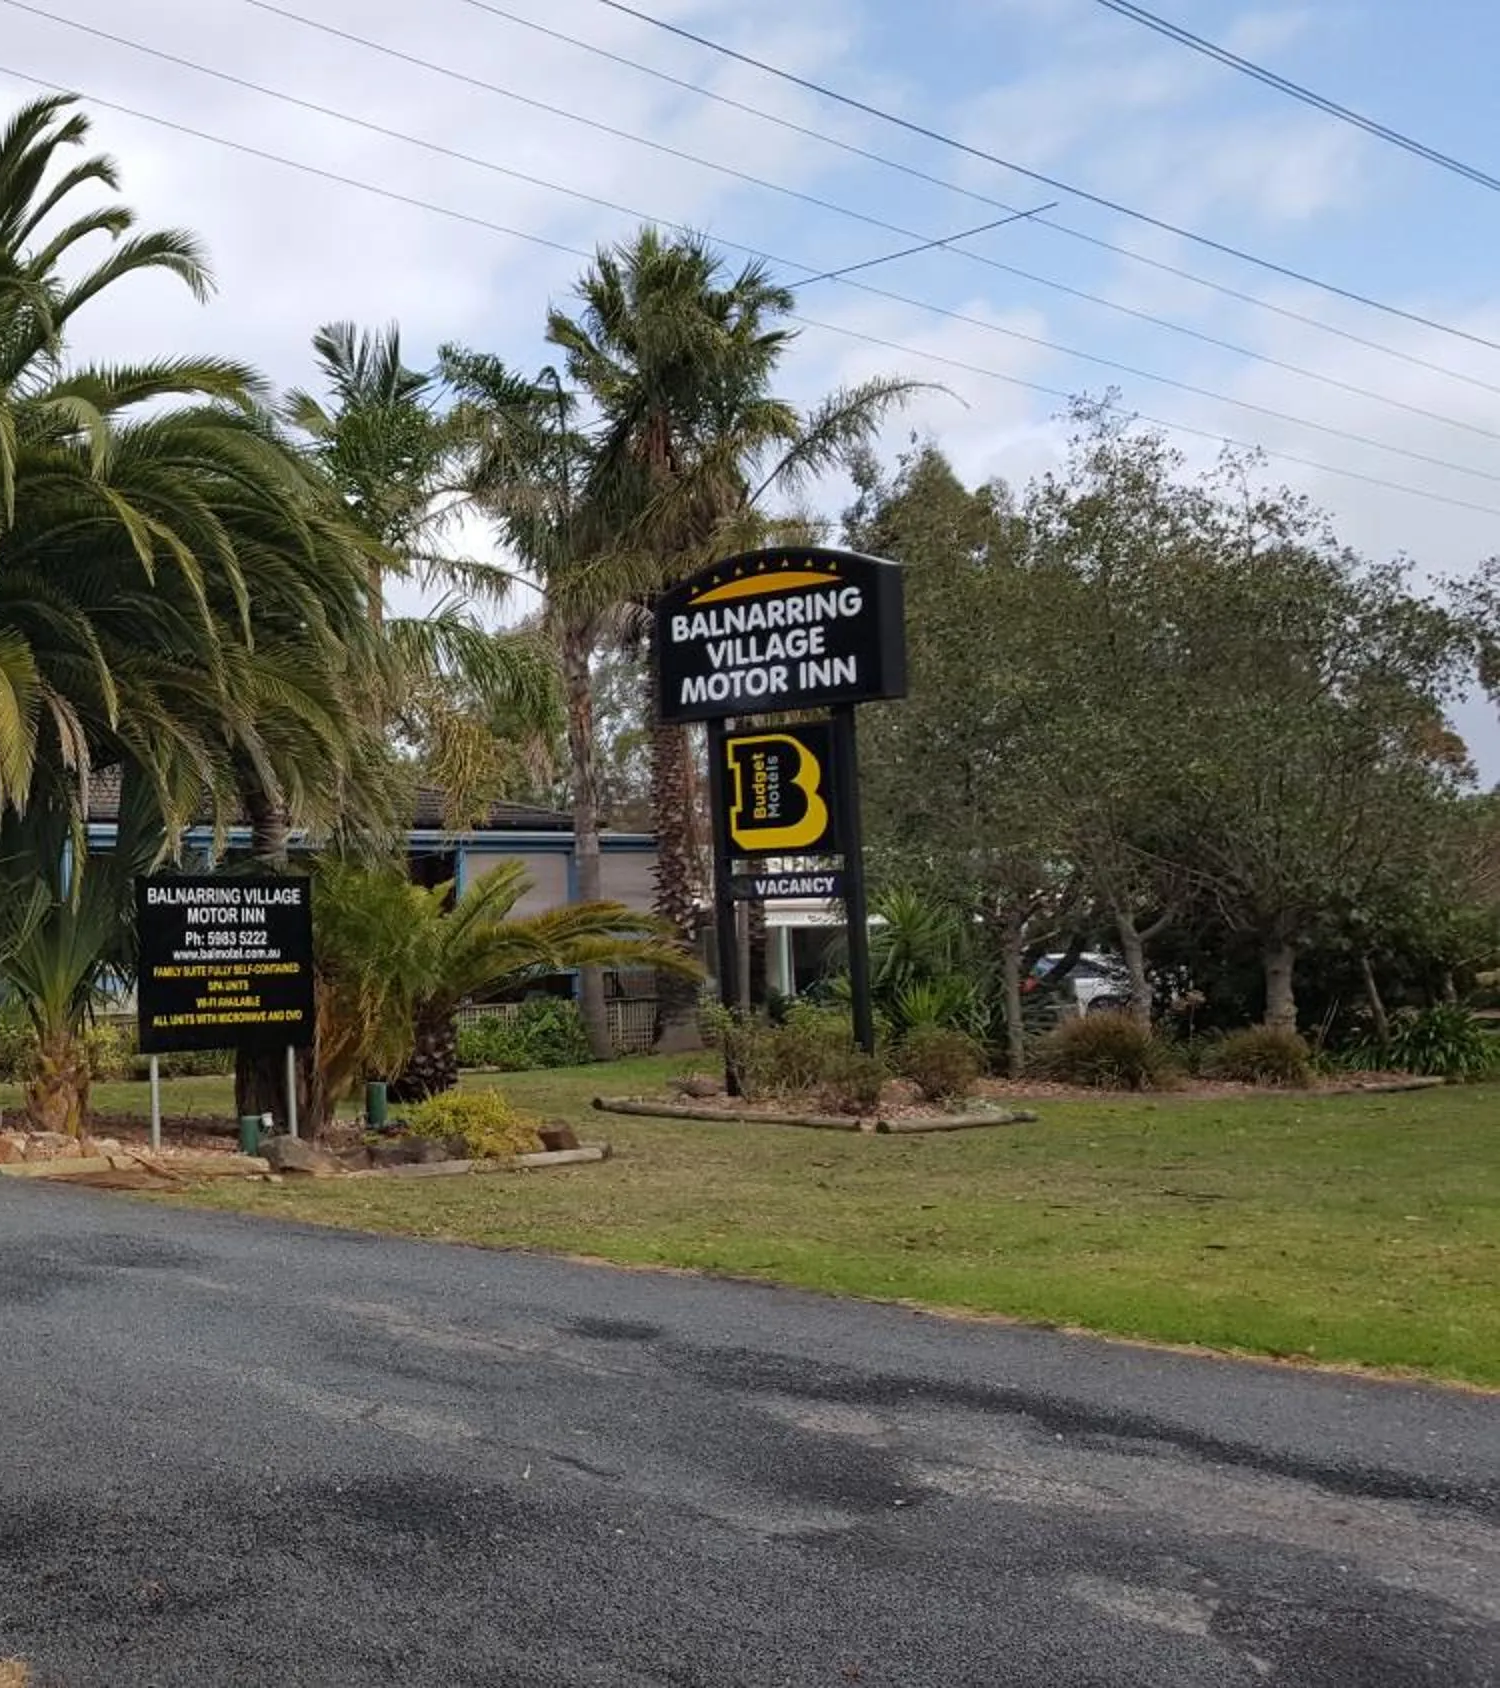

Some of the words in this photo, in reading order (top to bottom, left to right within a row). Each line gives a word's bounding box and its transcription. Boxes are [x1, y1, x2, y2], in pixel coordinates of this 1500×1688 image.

[671, 586, 863, 643] BALNARRING
[706, 626, 826, 669] VILLAGE
[680, 665, 788, 705] MOTOR
[799, 655, 857, 690] INN
[752, 752, 767, 819] Budget
[766, 755, 780, 818] Motels
[755, 876, 835, 895] VACANCY
[147, 887, 241, 904] BALNARRING
[243, 887, 302, 904] VILLAGE
[187, 907, 238, 924] MOTOR
[241, 907, 266, 923] INN
[185, 931, 205, 946] Ph:
[207, 931, 237, 945] 5983
[239, 930, 267, 945] 5222
[153, 965, 181, 977] FAMILY
[233, 962, 300, 975] SELF-CONTAINED
[218, 996, 260, 1007] AVAILABLE
[153, 1014, 169, 1026] ALL
[170, 1013, 194, 1026] UNITS
[196, 1012, 217, 1025] WITH
[218, 1010, 266, 1024] MICROWAVE
[267, 1009, 285, 1022] AND
